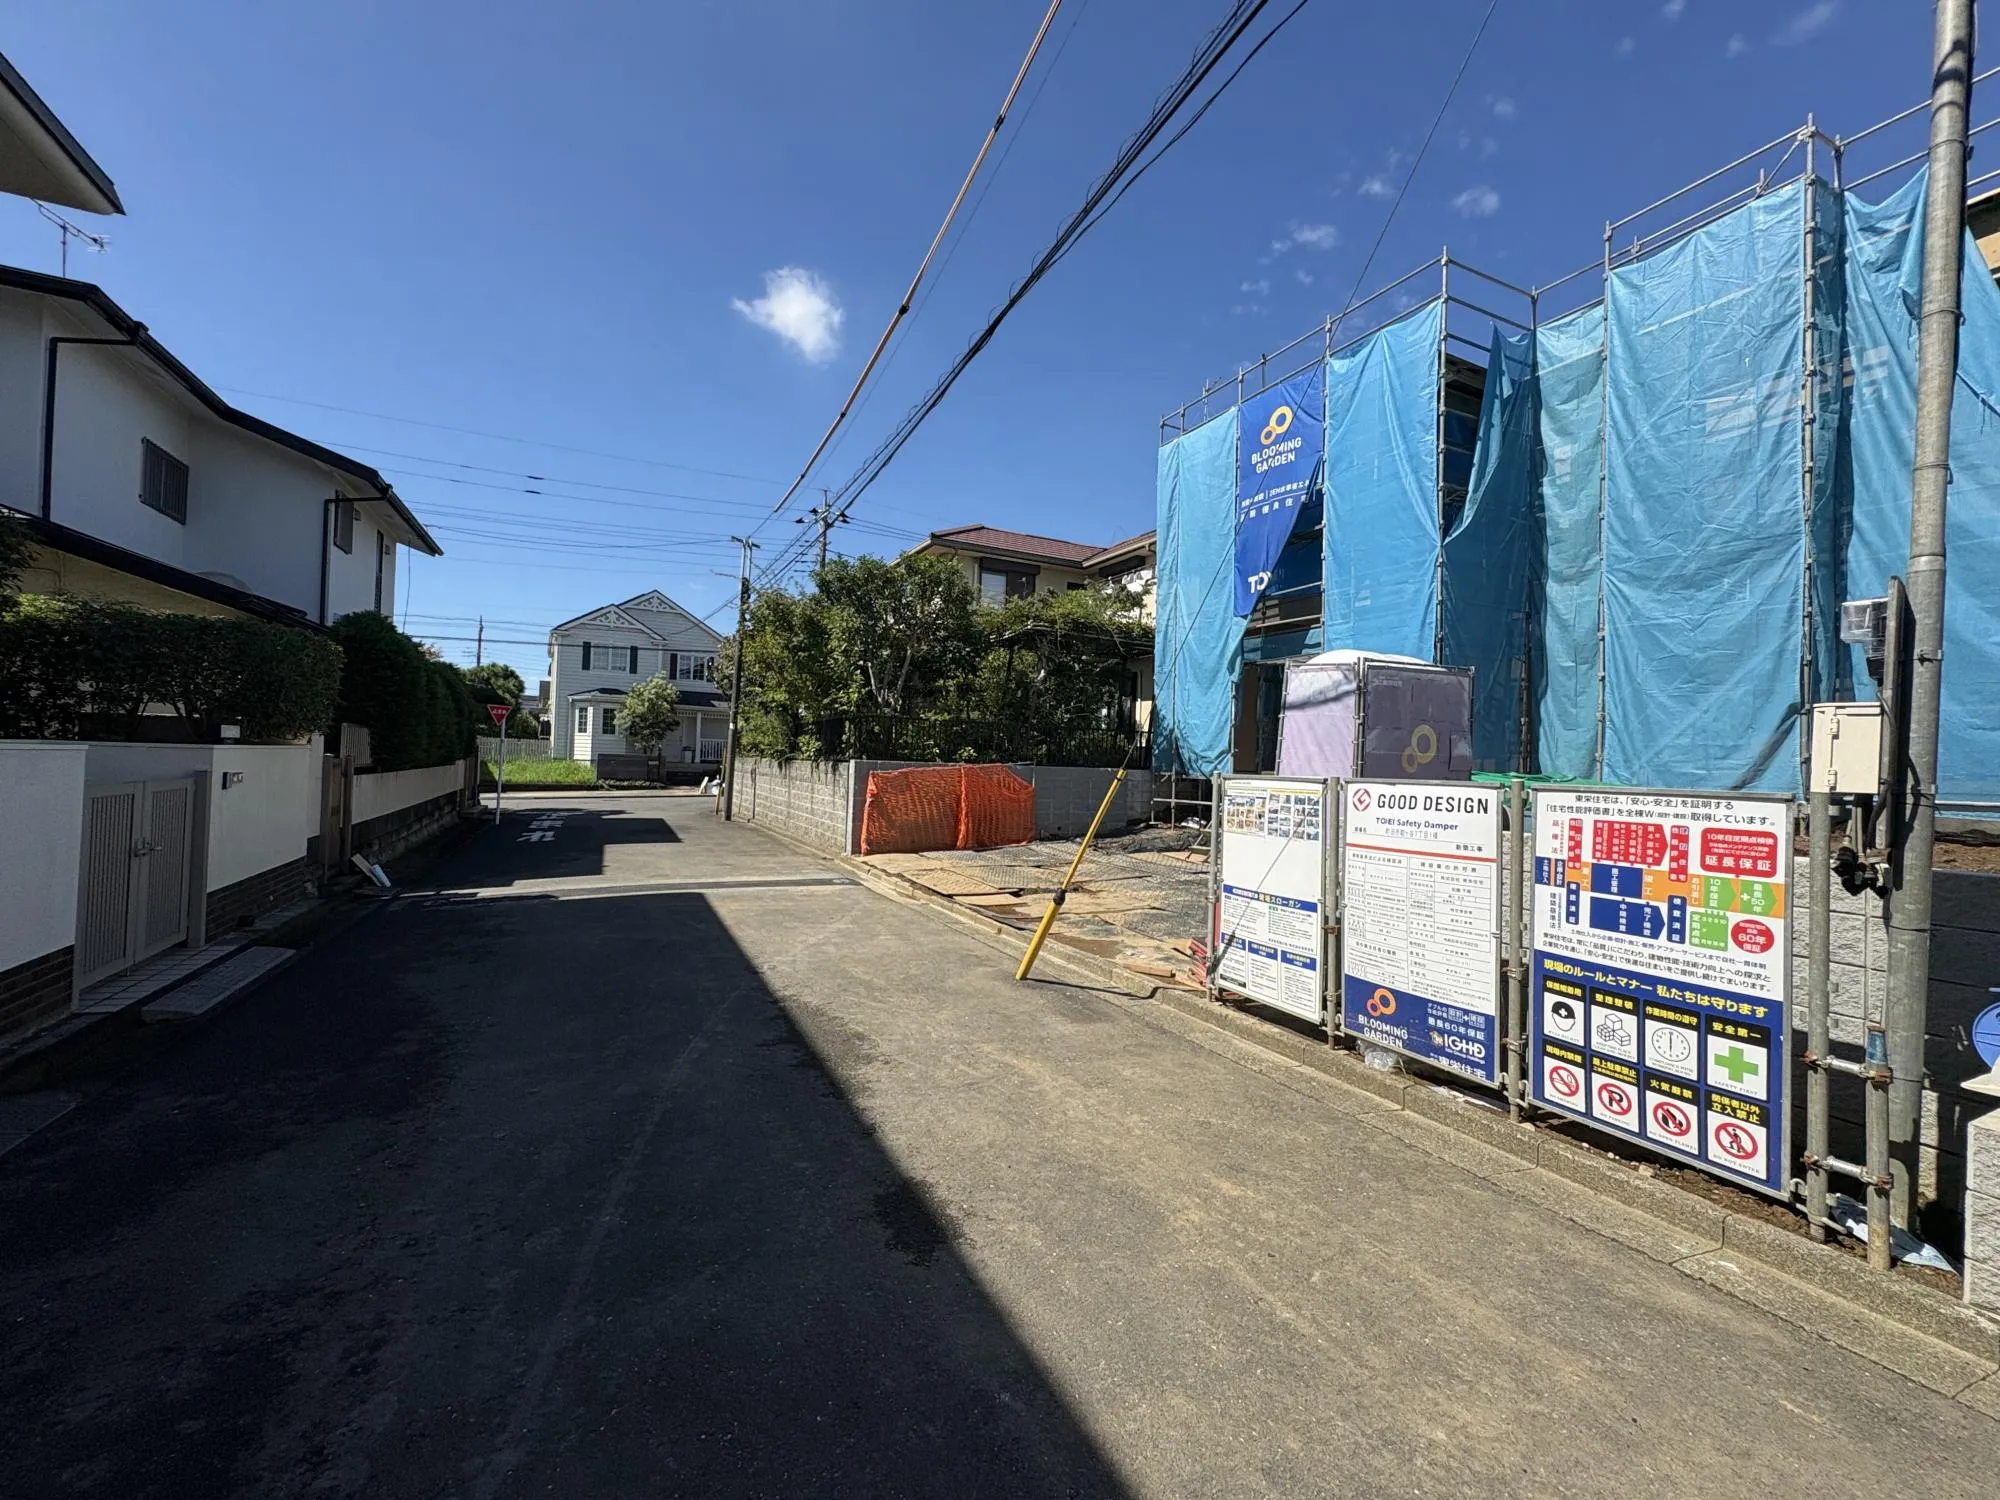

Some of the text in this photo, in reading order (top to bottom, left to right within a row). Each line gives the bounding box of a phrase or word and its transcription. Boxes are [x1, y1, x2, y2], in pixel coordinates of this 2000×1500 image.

[1251, 437, 1302, 465] BLOOMING
[1256, 451, 1296, 474] GARDEN
[1377, 793, 1489, 814] GOOD DESIGN
[1575, 794, 1734, 811] 東栄住宅は、「安心・安全」を証明する
[1397, 818, 1422, 829] Safety
[1424, 820, 1459, 831] Damper
[1595, 822, 1603, 858] 第1回検査
[1612, 823, 1620, 860] 第2回検査
[1629, 824, 1637, 862] 第3回検査
[1646, 826, 1654, 864] 第4回検査
[1705, 854, 1773, 872] 延長保証
[1643, 907, 1652, 936] 完了検査
[1737, 933, 1767, 946] 60年
[1743, 944, 1762, 954] 保証
[1543, 959, 1769, 1019] 現場のルールとマナー 私たちは守ります
[1594, 993, 1634, 1010] 整理整頓
[1358, 1014, 1409, 1040] BLOOMING
[1645, 1006, 1698, 1026] 作業時間の遵守
[1363, 1028, 1404, 1050] GARDEN
[1428, 1017, 1486, 1041] 最長60年保証
[1712, 1022, 1762, 1039] 安全第一
[1545, 1045, 1582, 1063] 現場内禁煙
[1592, 1057, 1637, 1078] 路上駐車禁止
[1649, 1079, 1693, 1100] 火気厳禁
[1711, 1093, 1760, 1115] 関係者以外
[1711, 1102, 1761, 1124] 立入禁止
